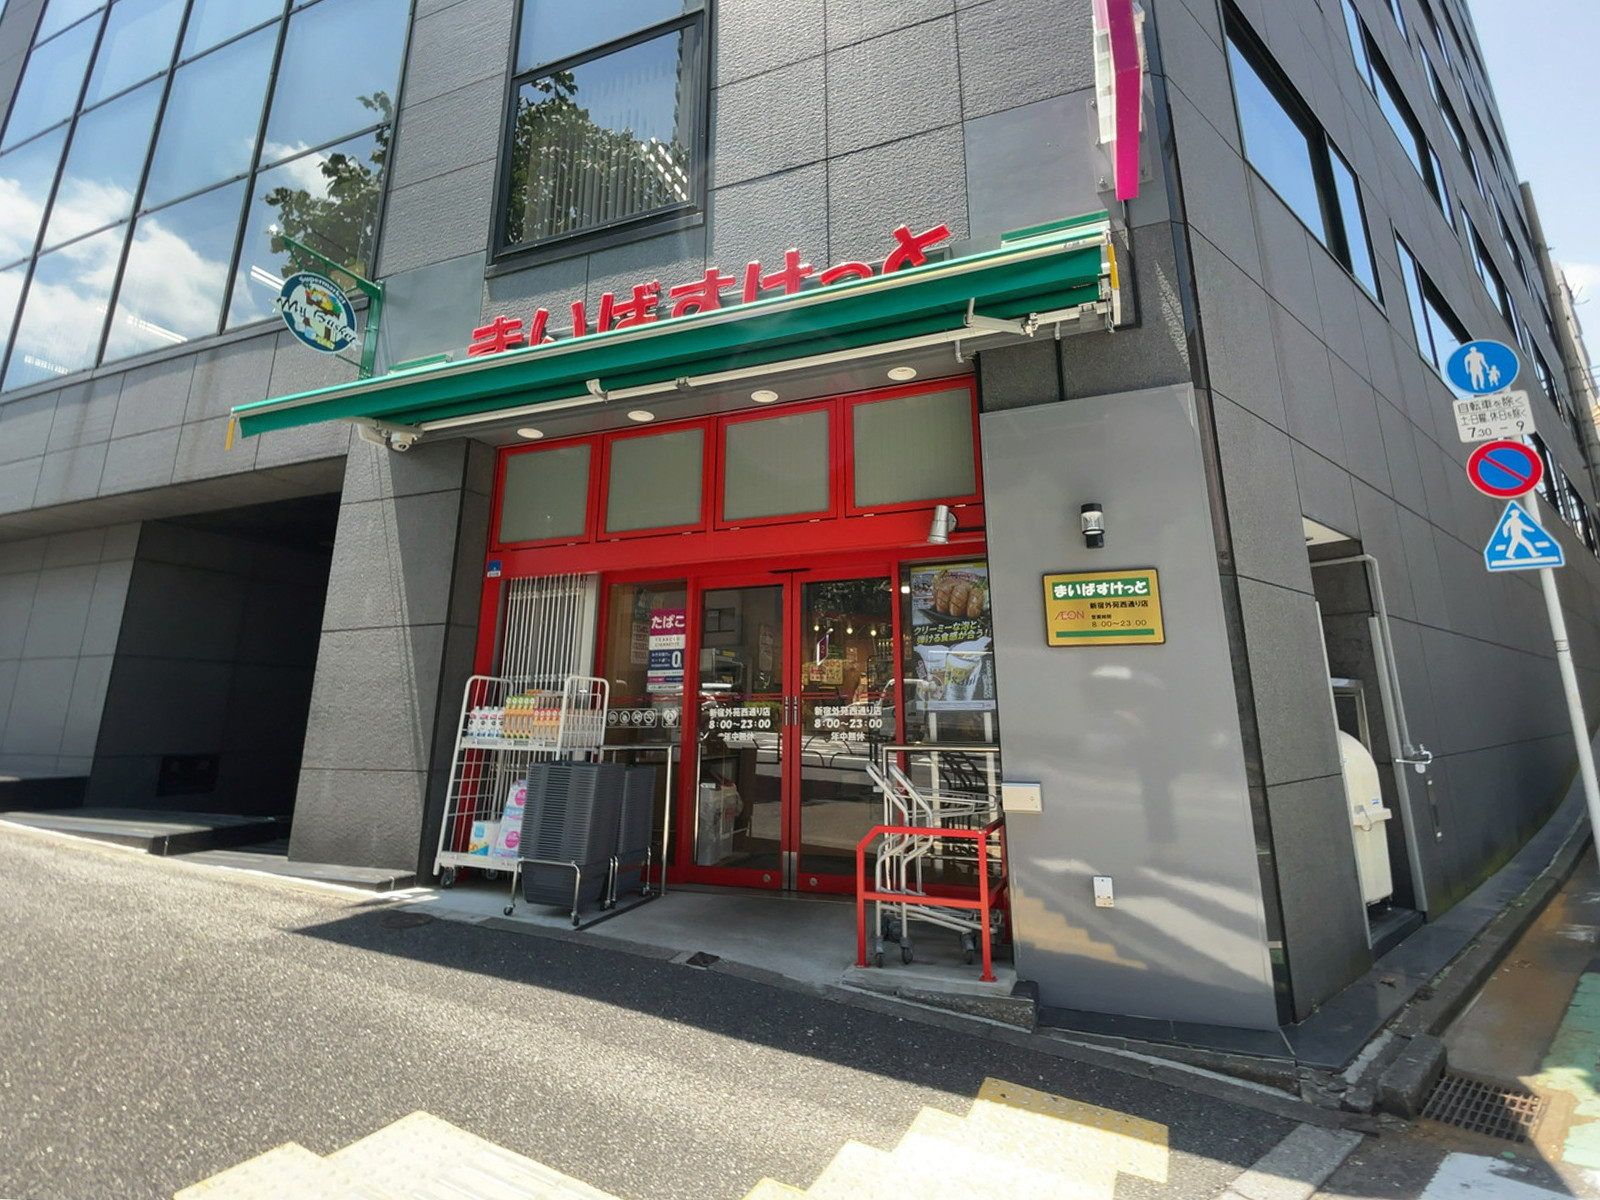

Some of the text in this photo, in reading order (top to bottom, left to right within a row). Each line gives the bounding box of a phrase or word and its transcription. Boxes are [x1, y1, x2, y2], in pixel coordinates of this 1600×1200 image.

[467, 224, 951, 357] まいばすけっと
[276, 297, 356, 343] My Basket
[1458, 396, 1525, 413] 自転車を除く
[1053, 581, 1148, 598] まいばすけっと
[1090, 600, 1148, 609] 新宿外苑西通り店
[651, 614, 685, 629] たばこ
[709, 707, 771, 718] 新宿外苑西通り店
[814, 706, 882, 717] 新宿外苑西通り店
[831, 731, 865, 742] 年中無休
